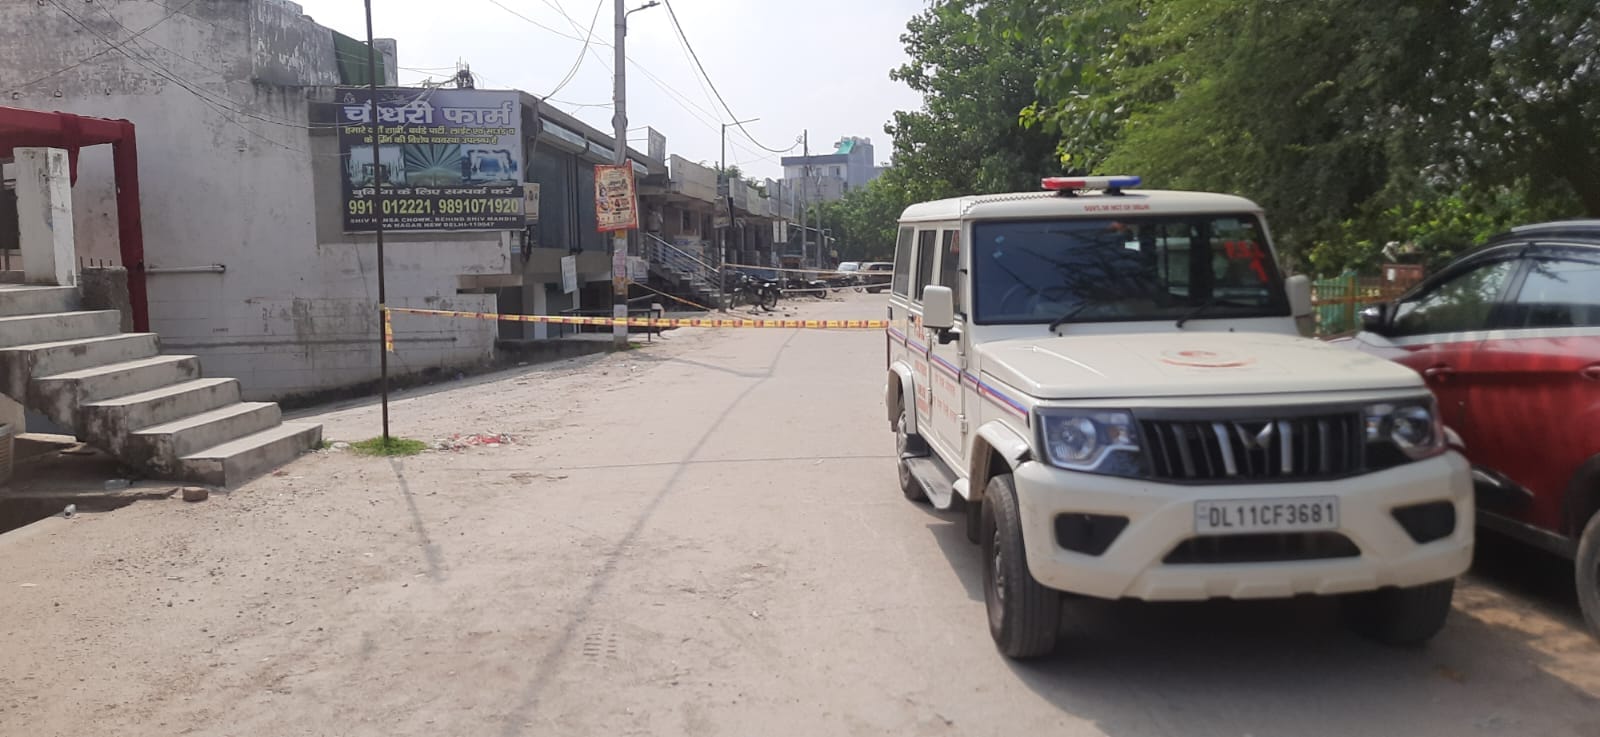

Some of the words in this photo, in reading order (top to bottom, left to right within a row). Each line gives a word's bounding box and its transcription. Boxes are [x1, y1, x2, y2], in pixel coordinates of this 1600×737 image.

[441, 101, 513, 124] फार्म
[397, 187, 412, 195] के
[415, 187, 441, 195] लिए
[444, 186, 488, 195] सम्पर्क
[348, 198, 435, 215] 991012221,
[438, 198, 519, 214] 9891071920
[1209, 503, 1335, 527] DL11CF3681
